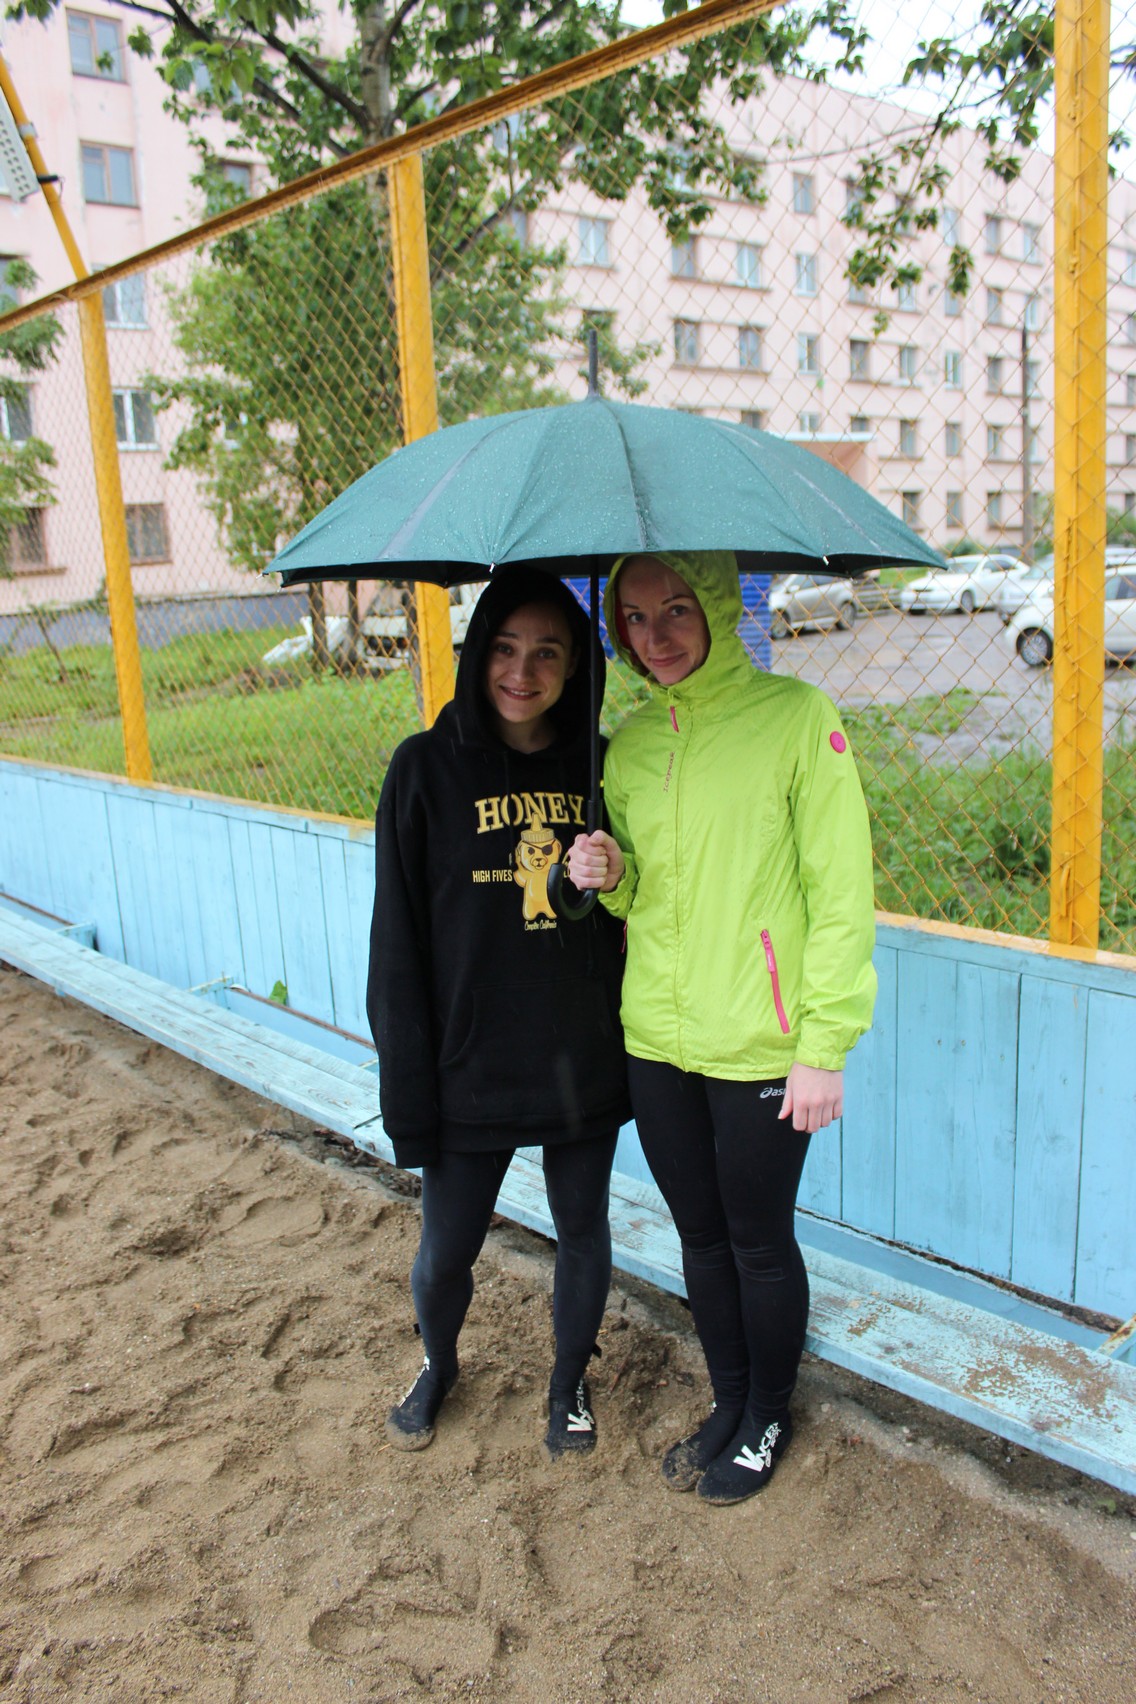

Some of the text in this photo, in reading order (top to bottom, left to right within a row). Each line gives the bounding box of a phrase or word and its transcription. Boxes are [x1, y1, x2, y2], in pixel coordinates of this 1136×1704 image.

[475, 792, 585, 834] HONEY
[472, 870, 513, 882] HIGH FIVES
